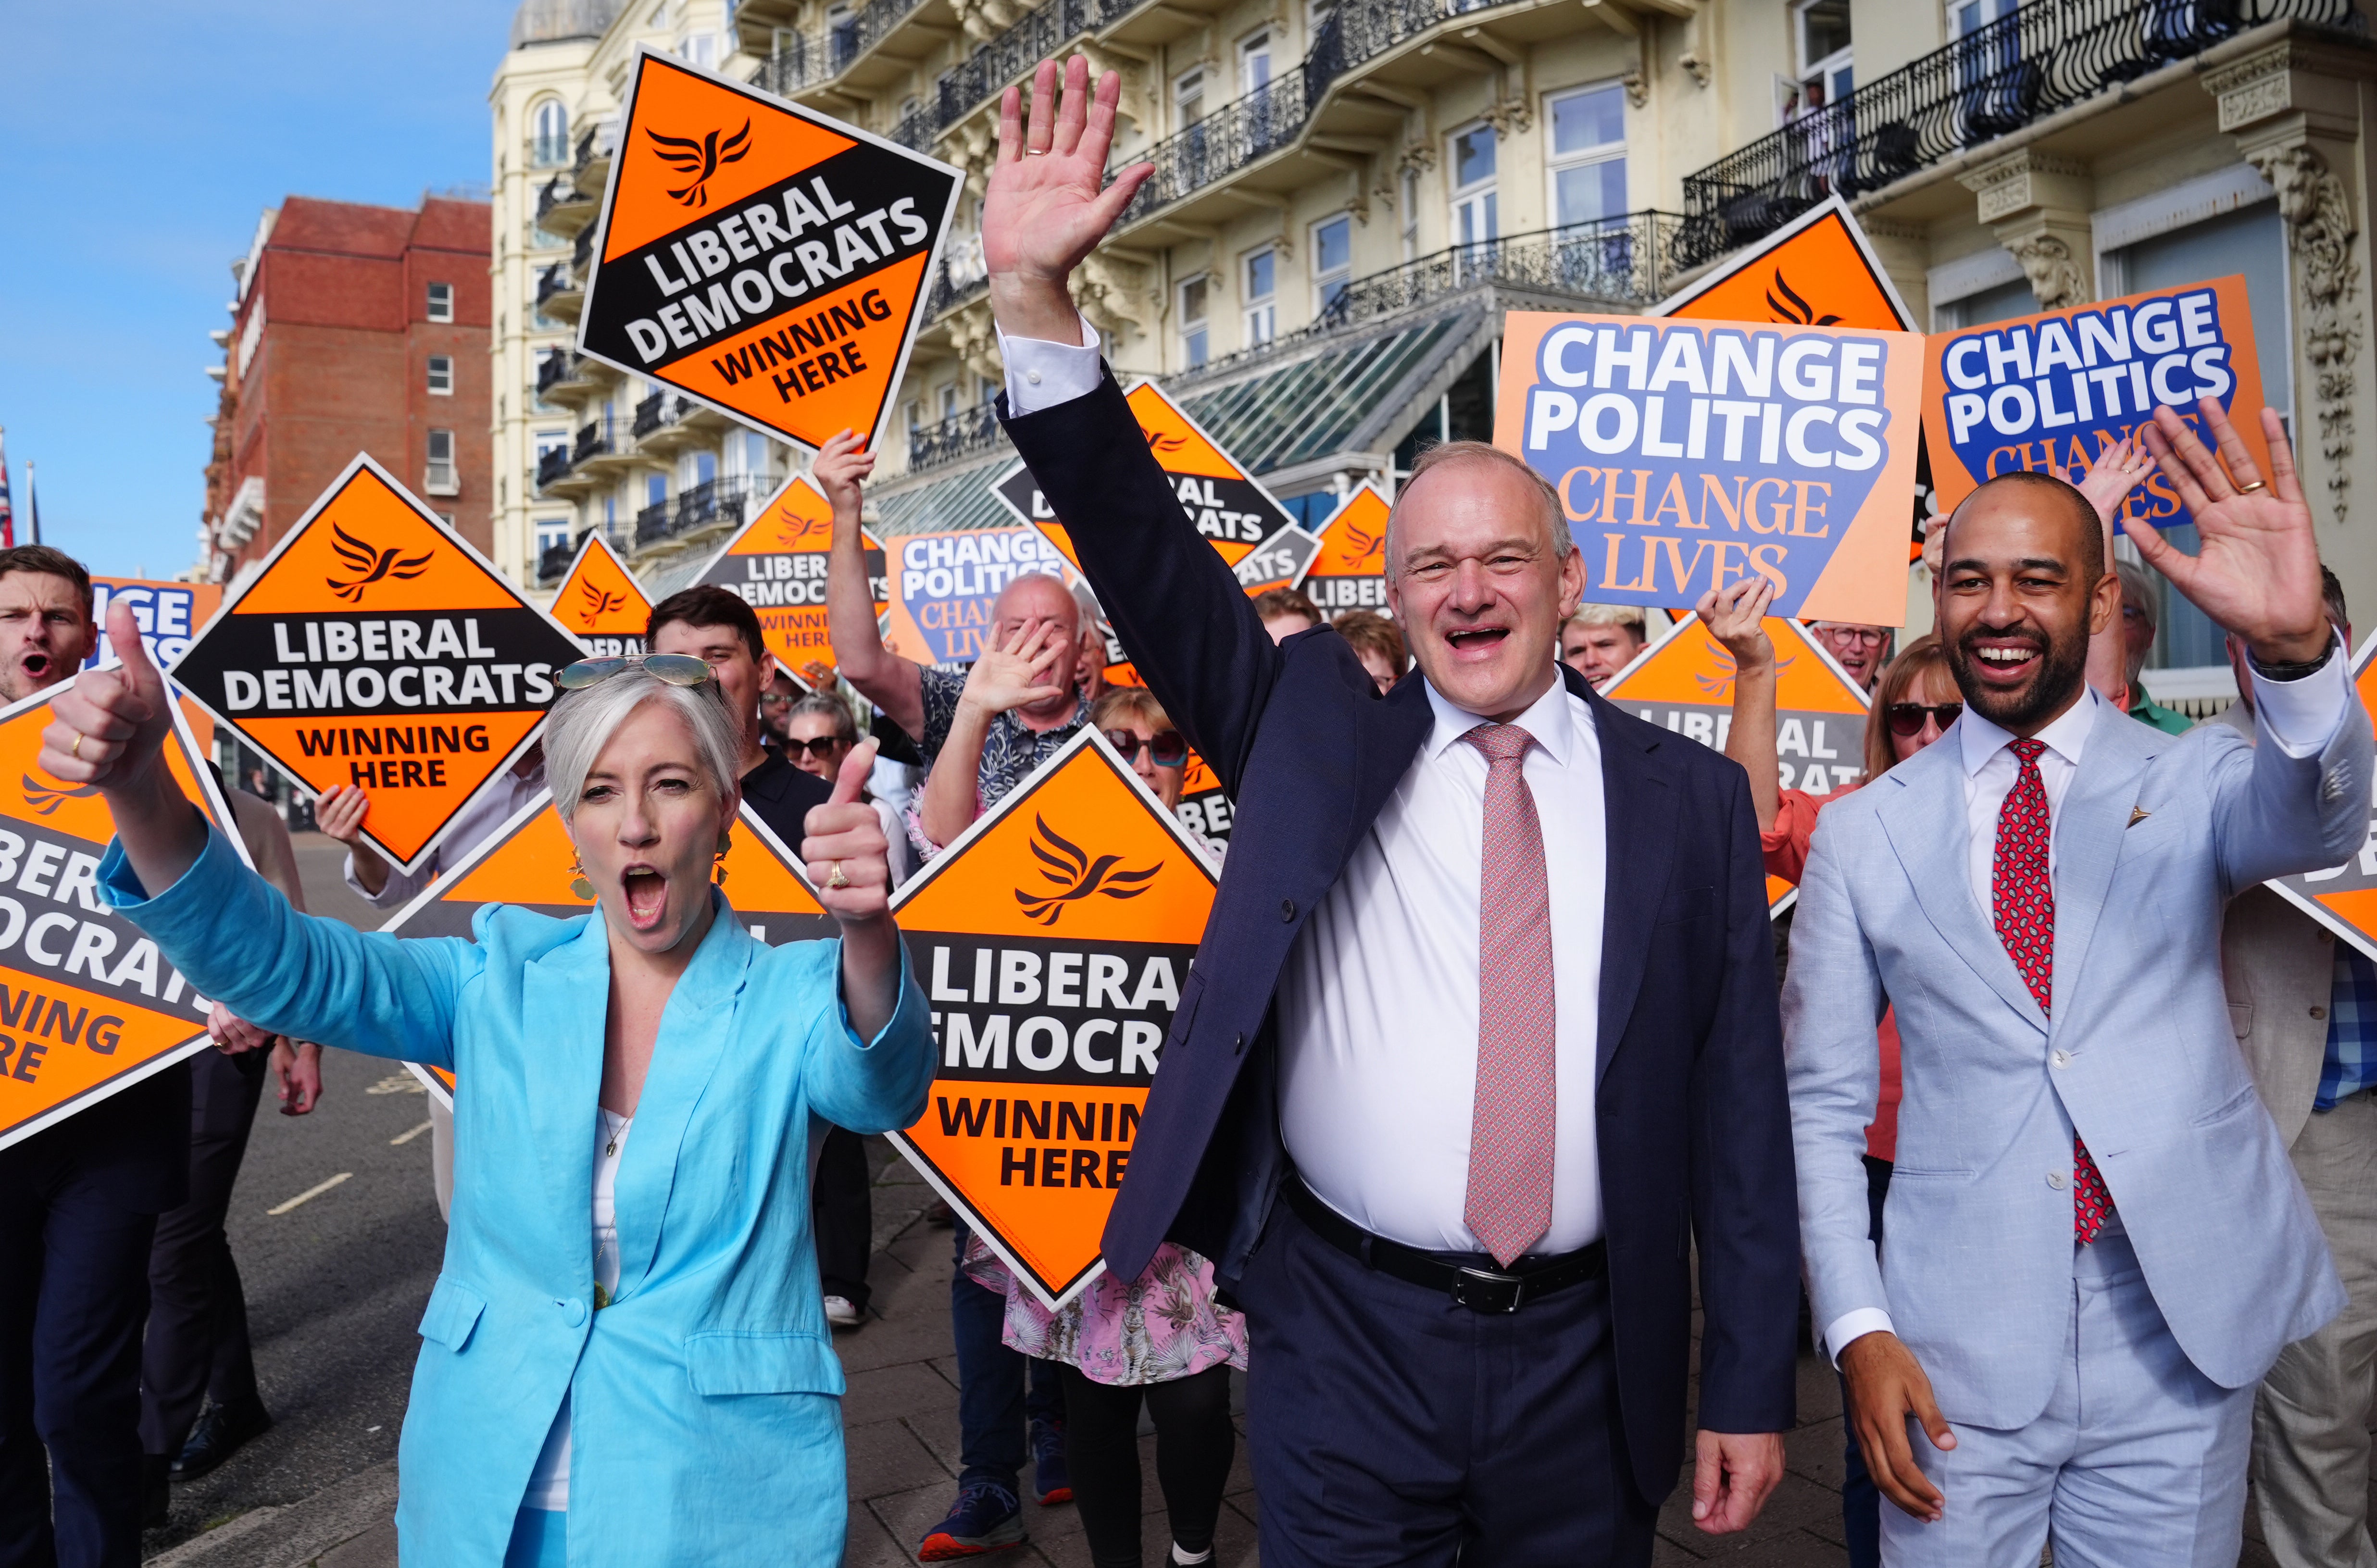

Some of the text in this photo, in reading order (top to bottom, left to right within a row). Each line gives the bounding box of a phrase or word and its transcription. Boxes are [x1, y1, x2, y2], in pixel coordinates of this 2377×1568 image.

[644, 176, 855, 297] LIBERAL
[625, 197, 928, 364] DEMOCRATS
[711, 289, 892, 386] WINNING
[1543, 327, 1880, 404] CHANGE
[1946, 293, 2215, 390] CHANGE
[771, 341, 867, 403] HERE
[1949, 348, 2230, 444] POLITICS
[1529, 390, 1884, 471] POLITICS
[1558, 466, 1831, 538] CHANGE
[747, 554, 828, 581] LIBER
[1598, 533, 1788, 600] LIVES
[274, 618, 495, 663] LIBERAL
[759, 612, 829, 630] WINNI
[786, 631, 831, 647] HER
[223, 663, 554, 710] DEMOCRATS
[296, 725, 489, 757] WINNING
[350, 759, 447, 788] HERE
[931, 946, 1193, 1011] LIBERA
[0, 983, 125, 1055] NING
[937, 1096, 1143, 1142] WINNIN
[1001, 1146, 1131, 1189] HERE
